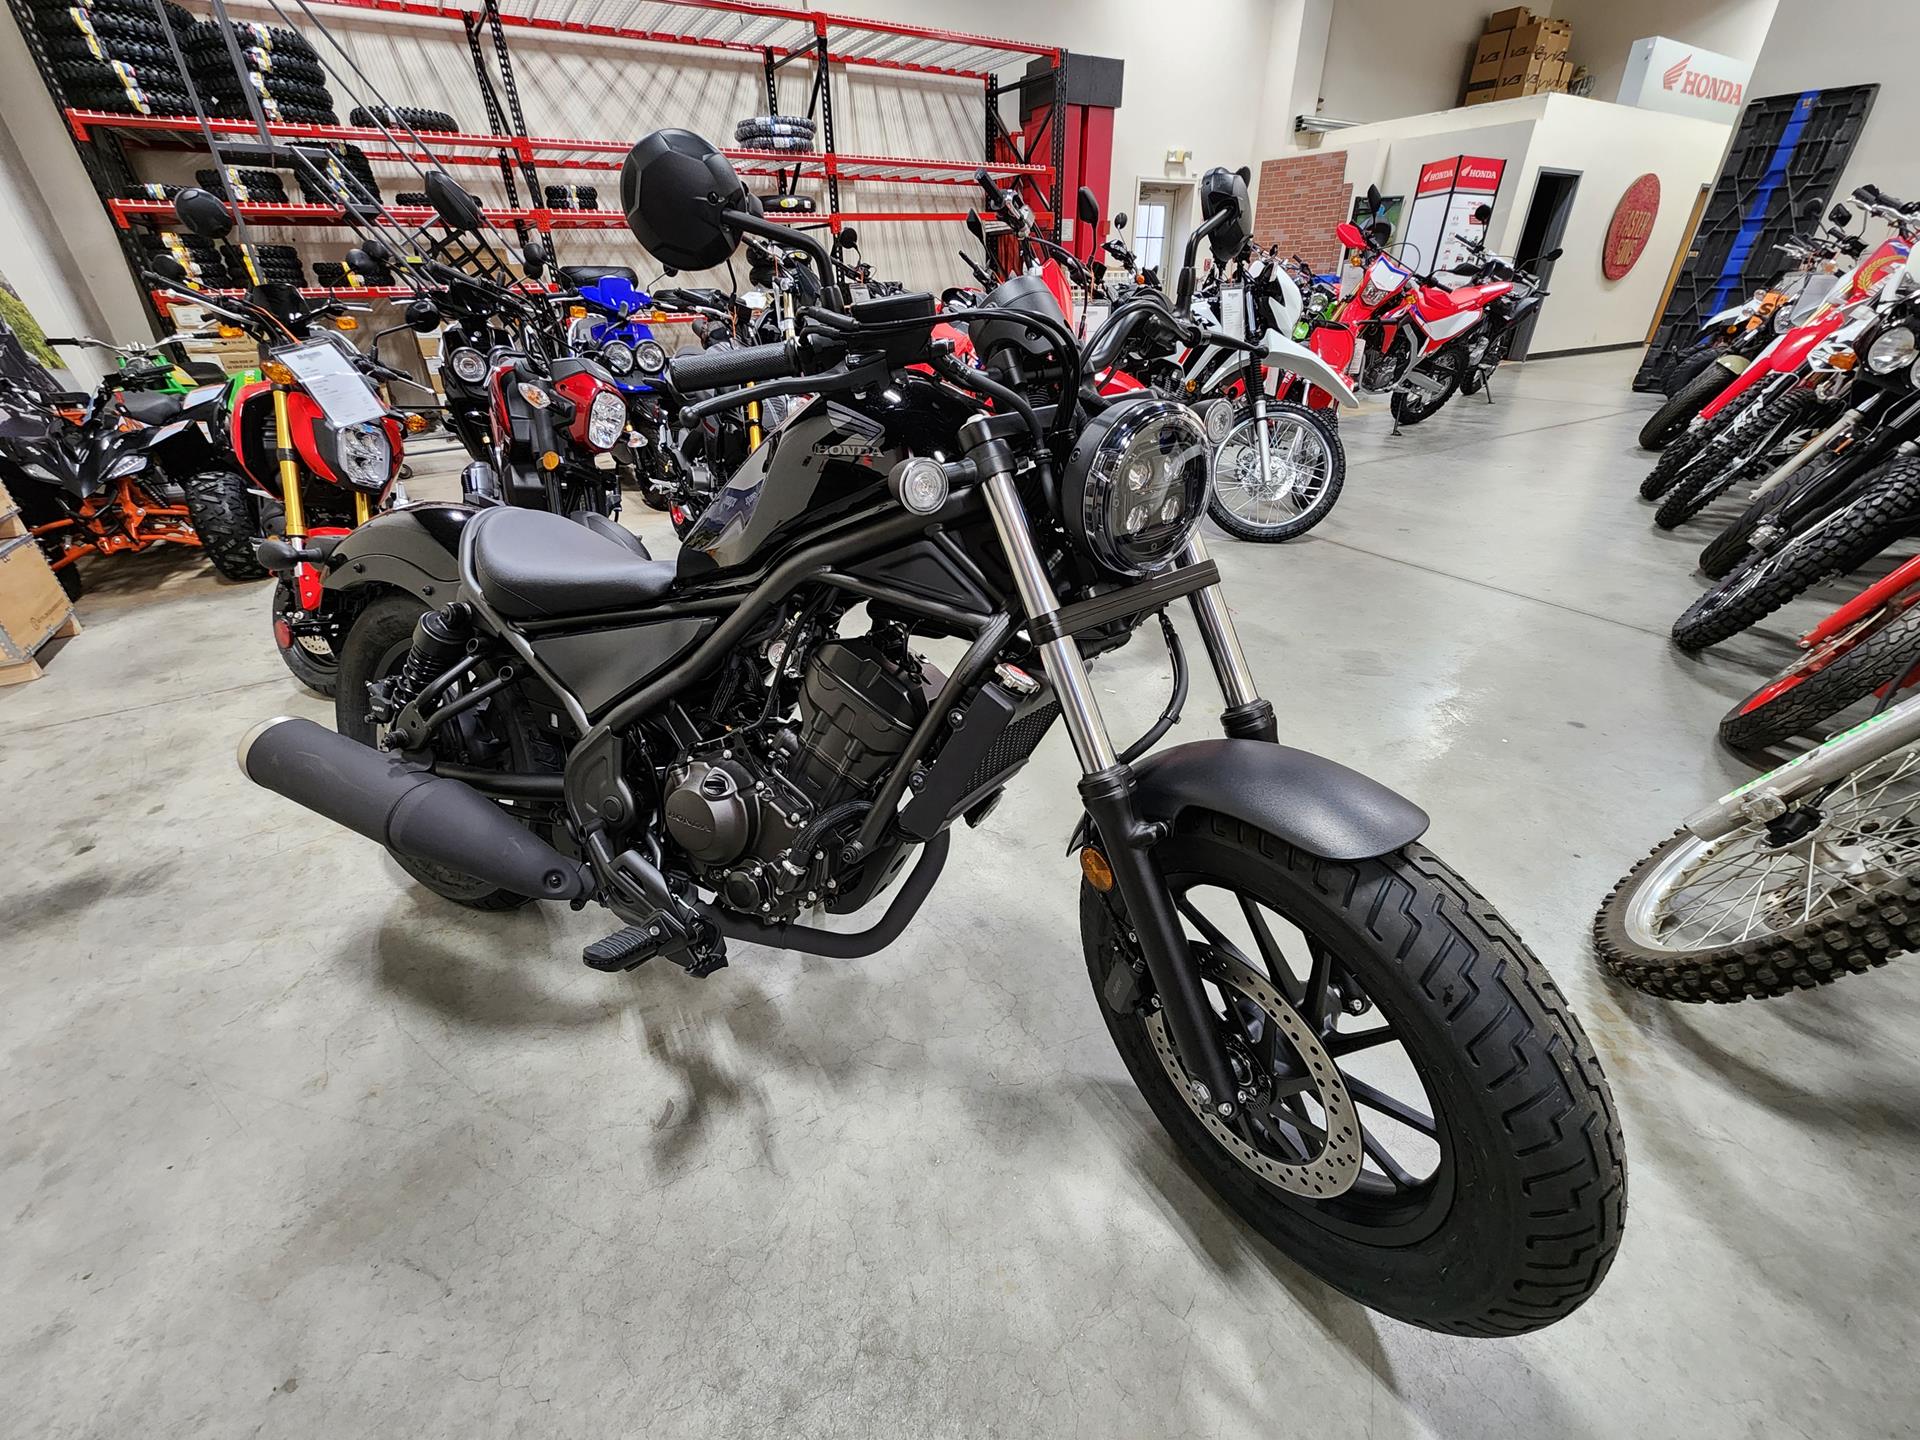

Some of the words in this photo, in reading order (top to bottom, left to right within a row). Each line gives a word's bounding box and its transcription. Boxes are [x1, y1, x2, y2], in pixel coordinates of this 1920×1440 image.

[1680, 70, 1743, 106] HONDA
[1428, 169, 1454, 182] HONDA
[1469, 169, 1497, 179] HONDA
[1618, 210, 1651, 238] FASTER
[814, 443, 885, 458] HONDA
